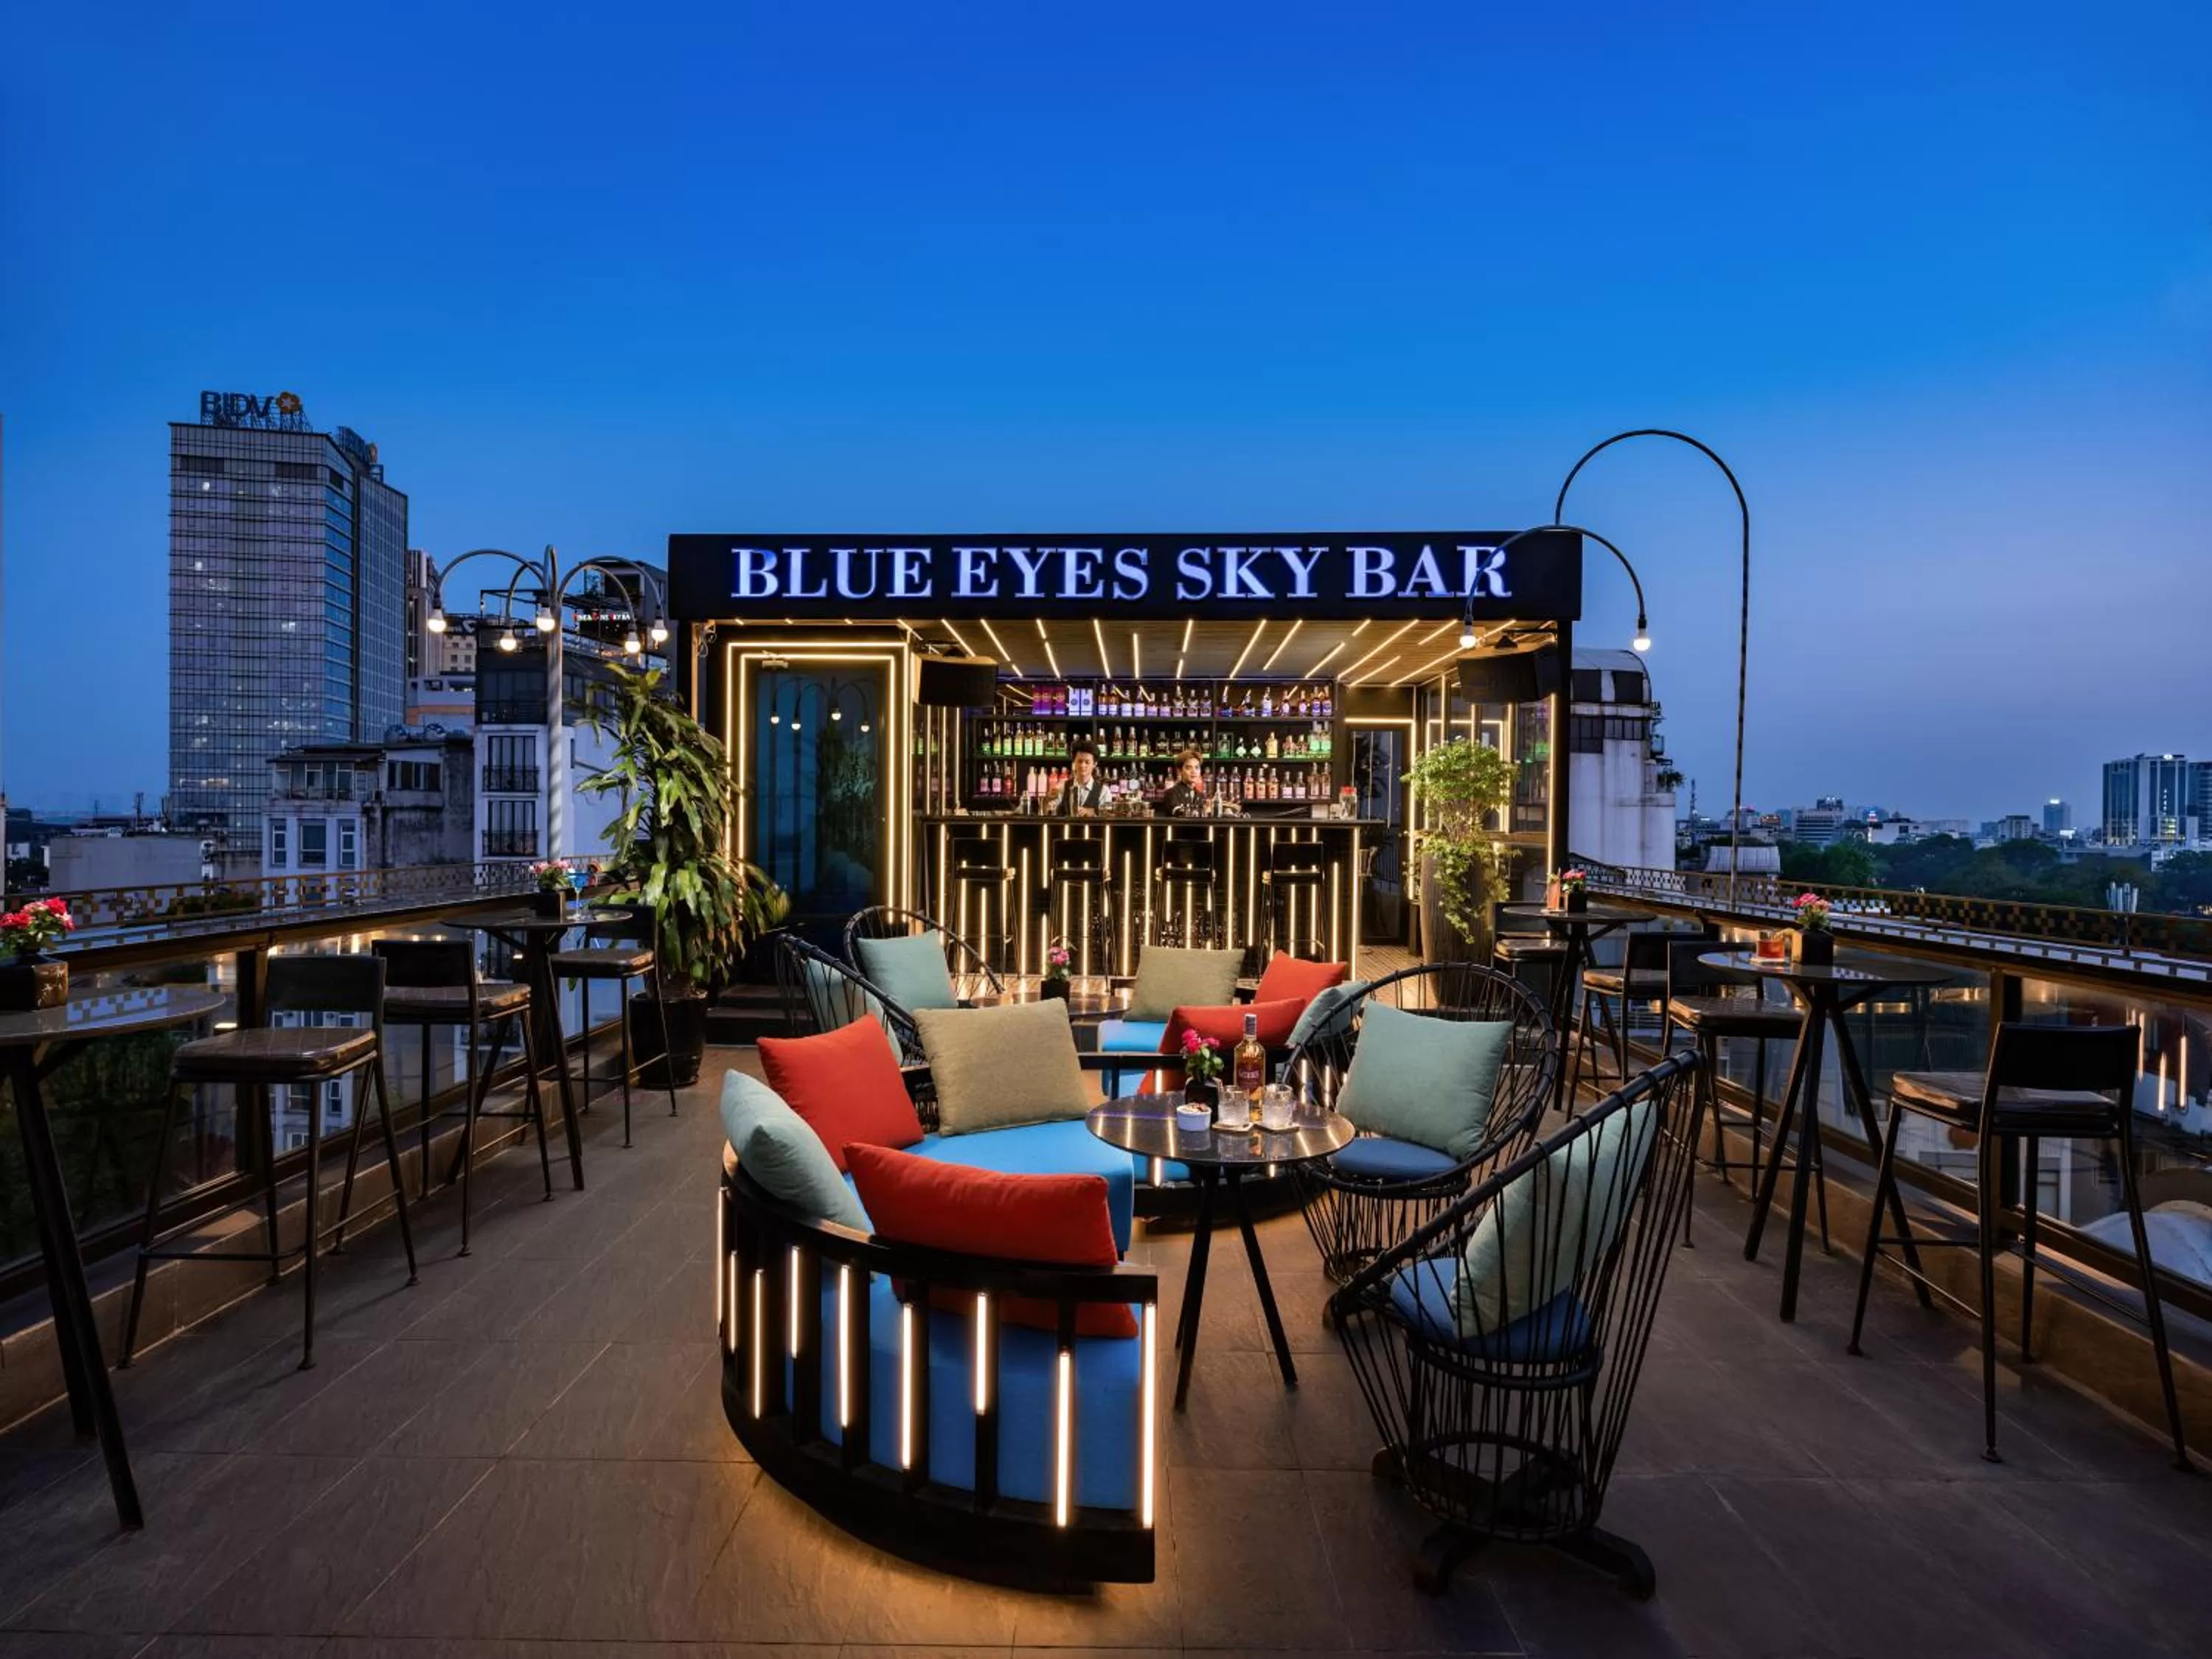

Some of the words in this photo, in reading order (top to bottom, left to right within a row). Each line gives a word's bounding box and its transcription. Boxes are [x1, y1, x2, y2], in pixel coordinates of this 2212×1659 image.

[201, 390, 275, 418] BIDV
[731, 547, 933, 599] BLUE
[950, 546, 1150, 601] EYES
[1176, 546, 1329, 601] SKY
[1344, 545, 1513, 598] BAR
